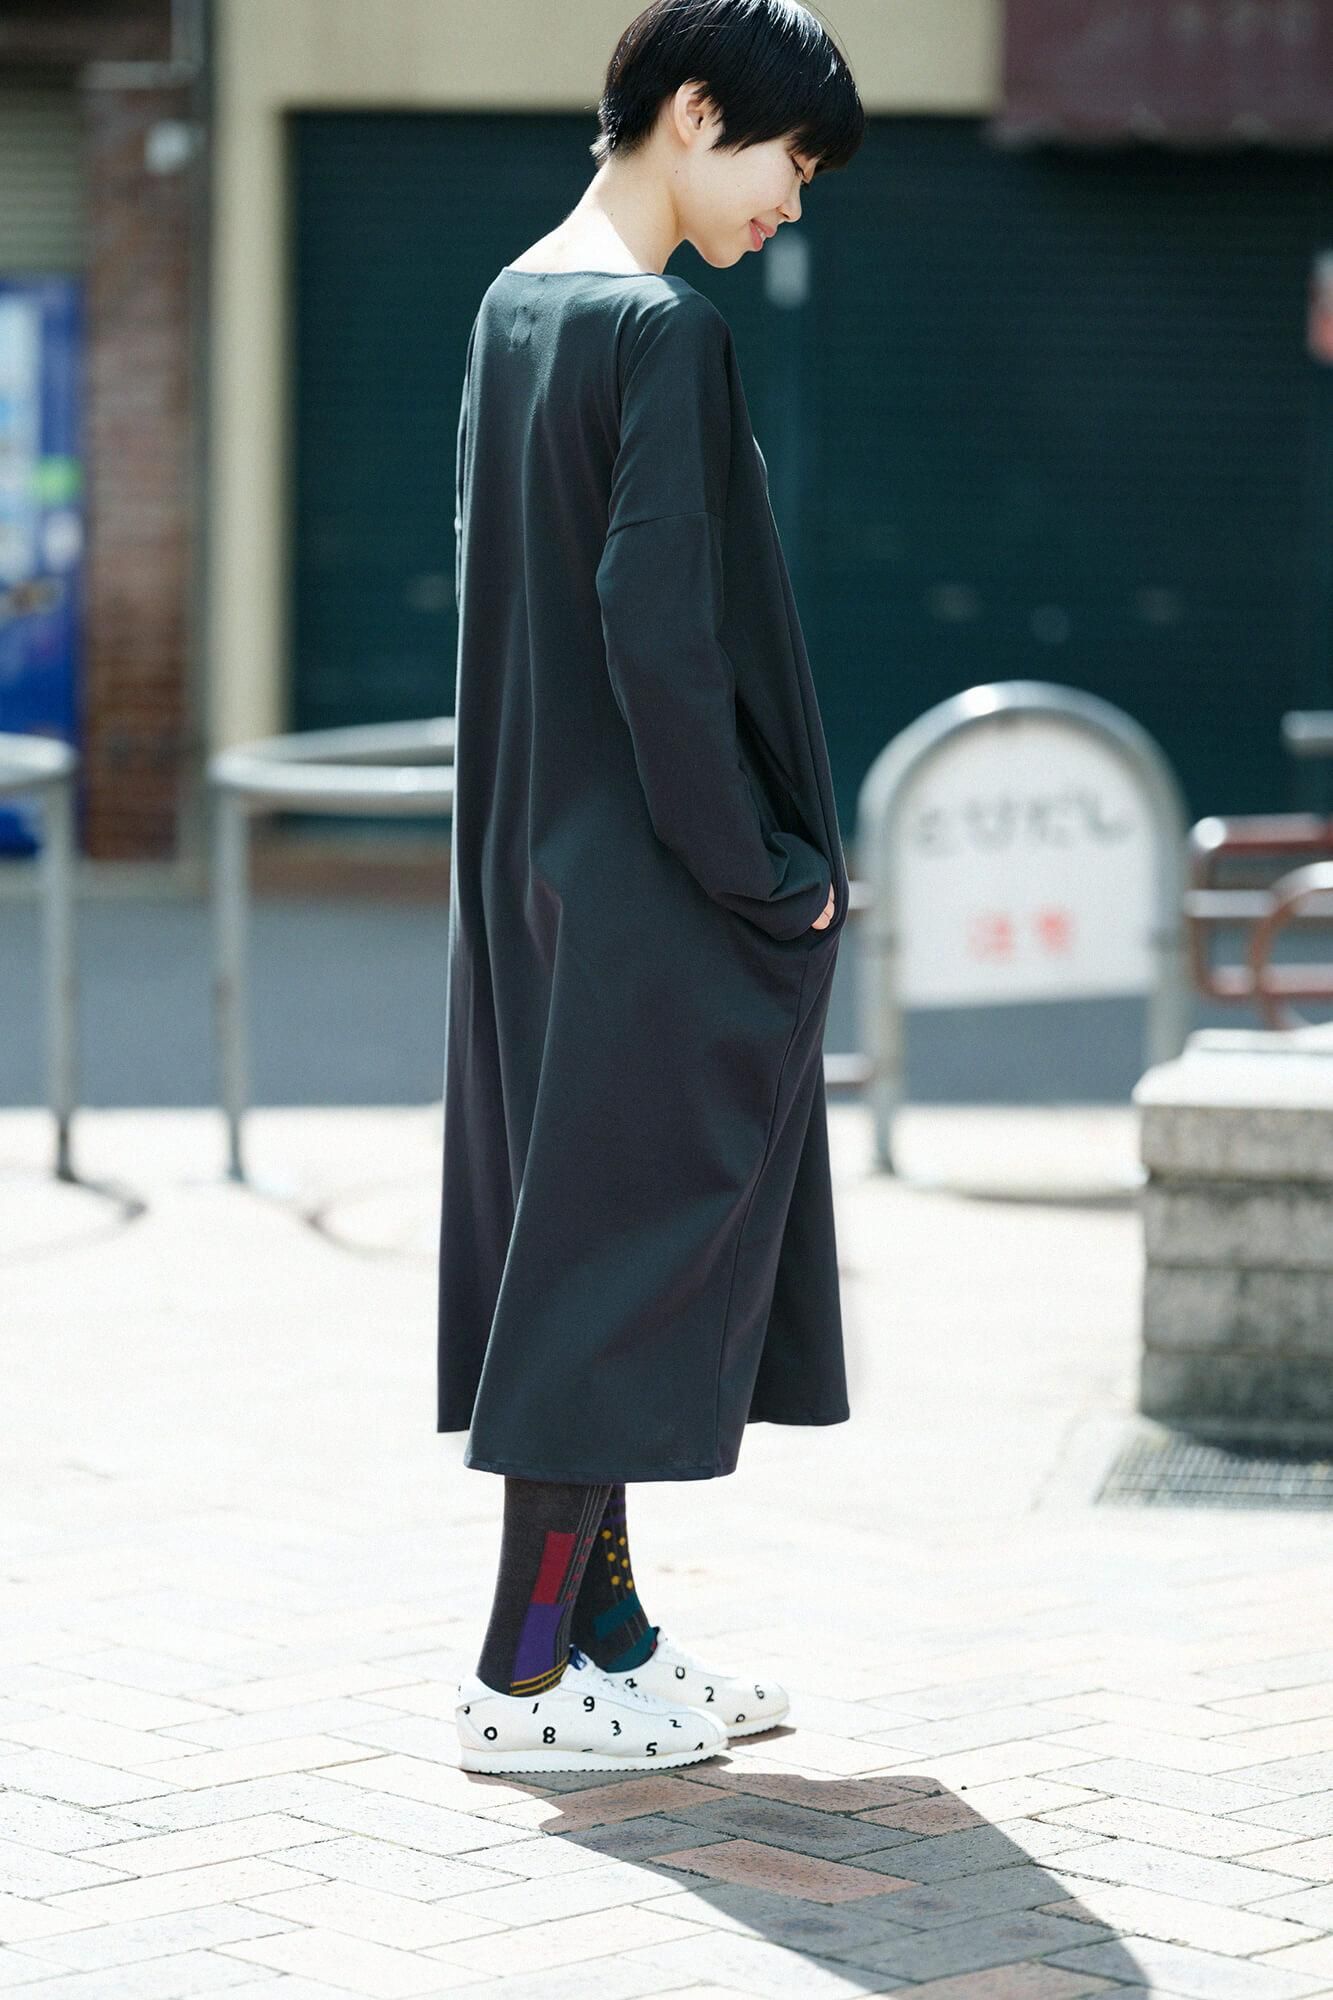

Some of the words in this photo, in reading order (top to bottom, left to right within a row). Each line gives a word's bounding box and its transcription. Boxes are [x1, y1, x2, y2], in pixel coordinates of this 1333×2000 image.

[704, 1685, 715, 1703] 2
[754, 1684, 766, 1700] 6
[582, 1695, 597, 1713] 9
[610, 1719, 623, 1737] 3
[668, 1718, 683, 1729] 2
[483, 1725, 499, 1742] 0
[542, 1725, 557, 1745] 8
[645, 1740, 660, 1758] 5
